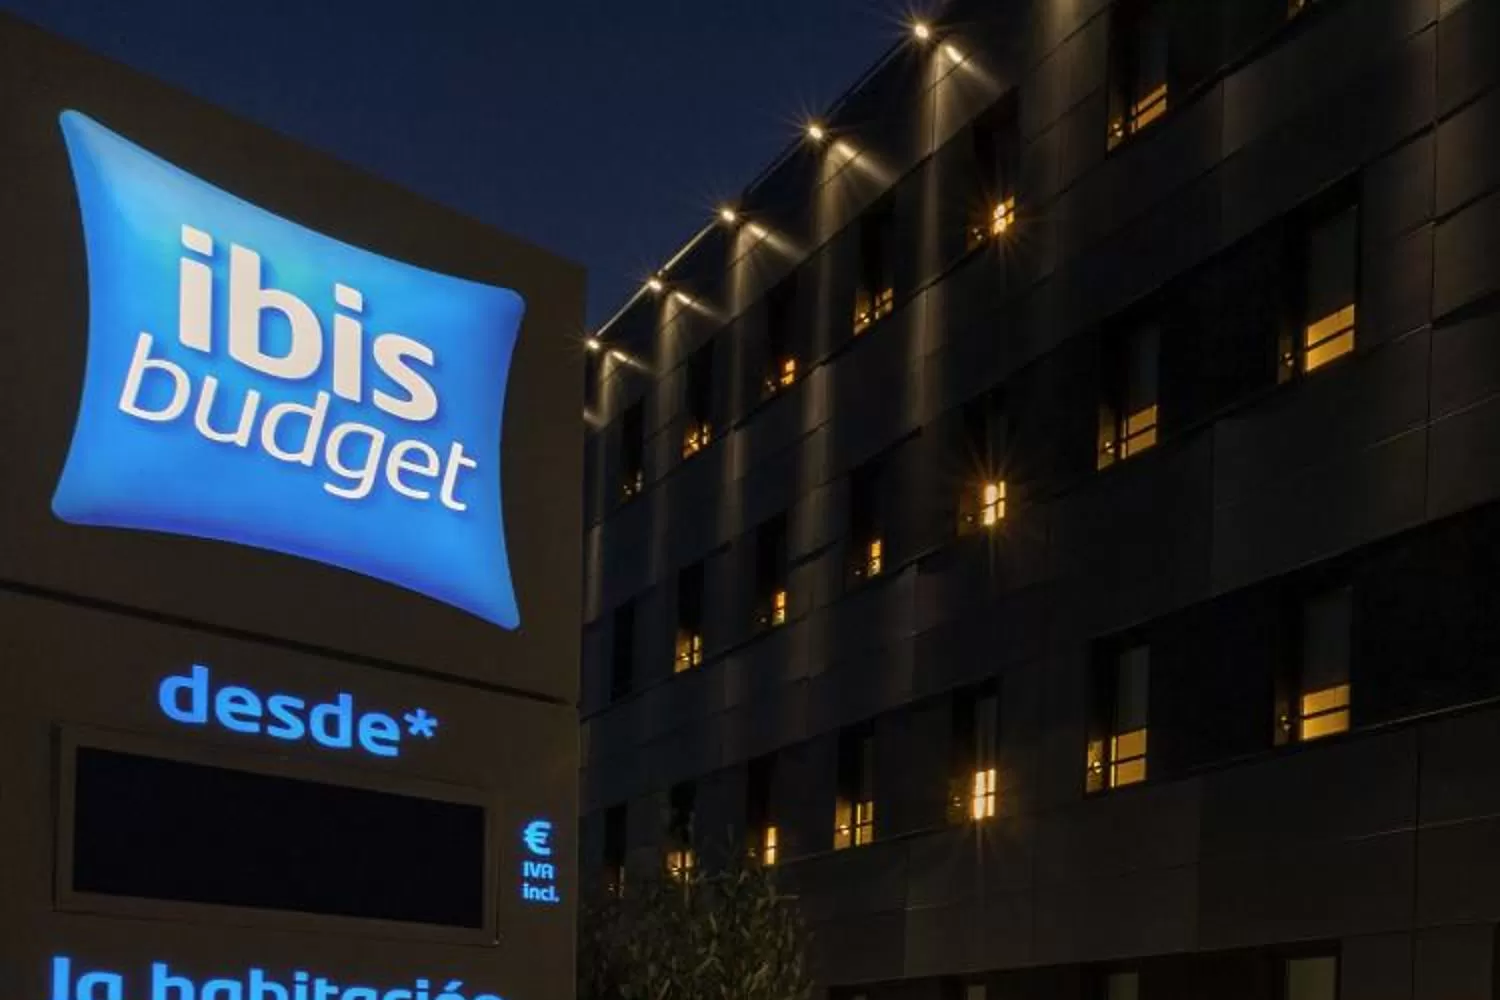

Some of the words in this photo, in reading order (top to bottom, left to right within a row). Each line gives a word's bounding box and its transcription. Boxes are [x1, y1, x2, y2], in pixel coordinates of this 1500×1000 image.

[178, 223, 439, 423] ibis
[118, 332, 478, 513] budget
[522, 860, 556, 880] IVA
